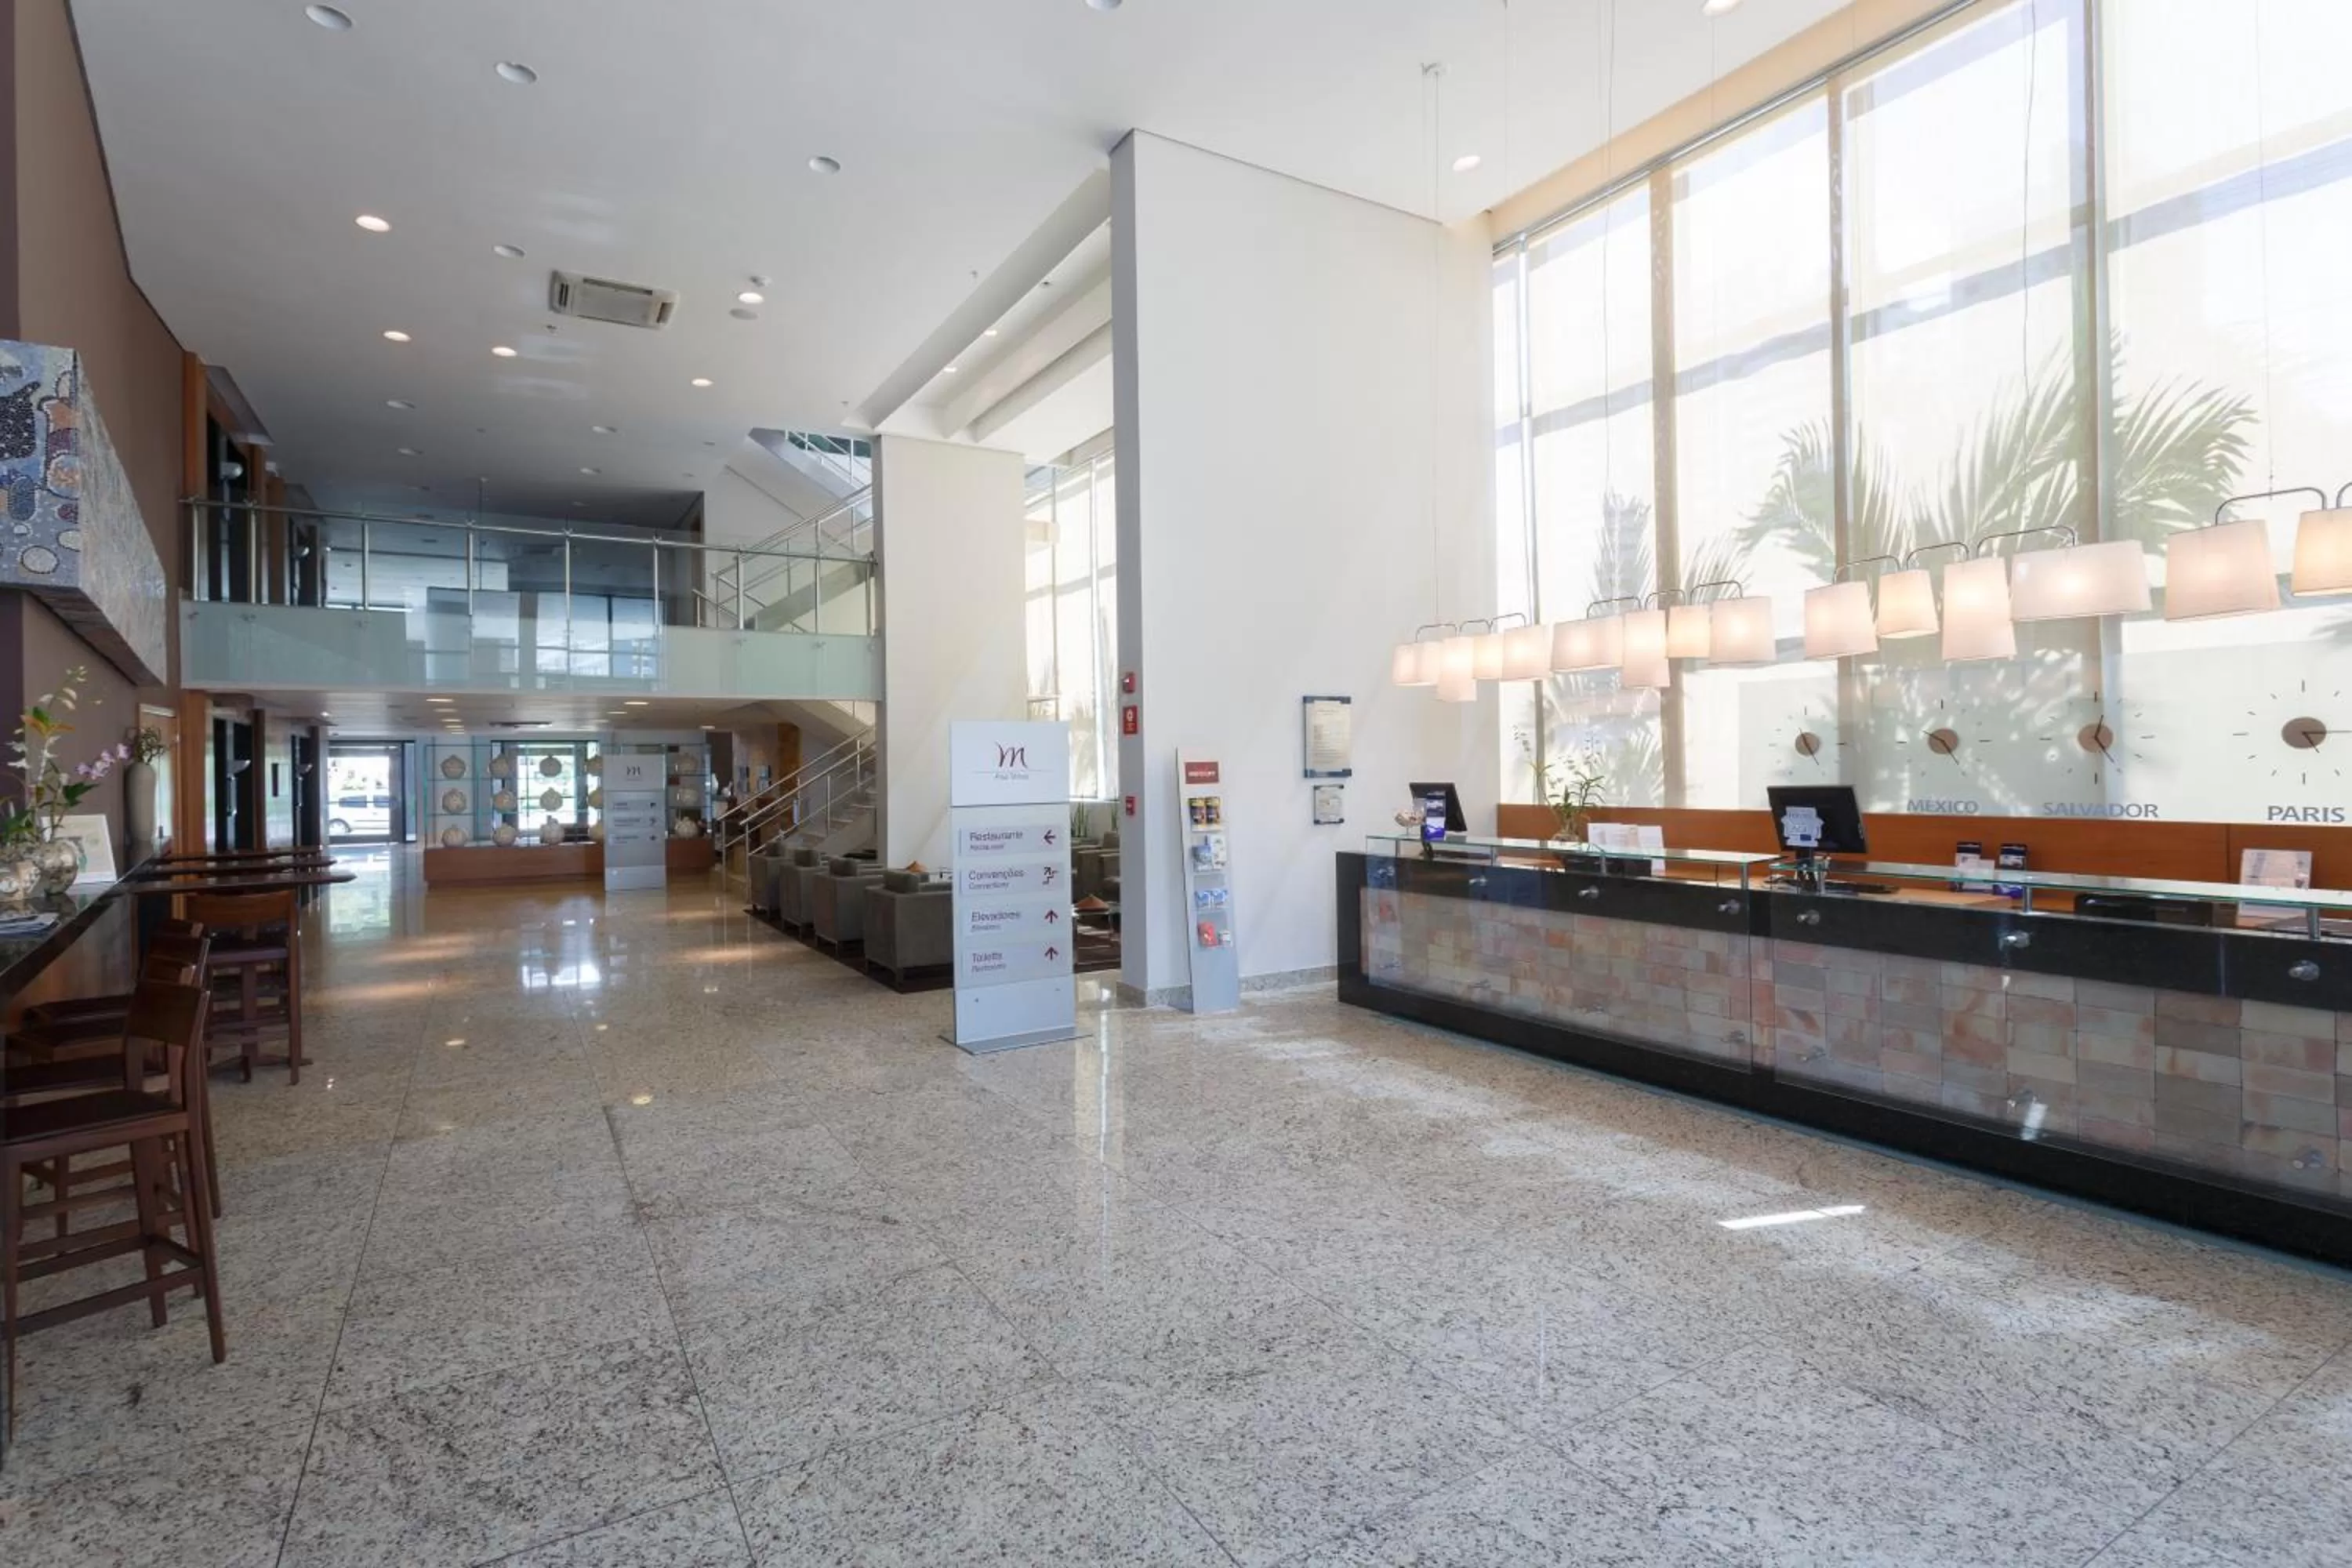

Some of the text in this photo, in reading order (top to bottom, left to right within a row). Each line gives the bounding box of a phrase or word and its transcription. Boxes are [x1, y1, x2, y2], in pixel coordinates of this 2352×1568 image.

[1906, 799, 1980, 814] MEXICO
[2043, 802, 2158, 818] SALVADOR
[2267, 805, 2346, 823] PARIS
